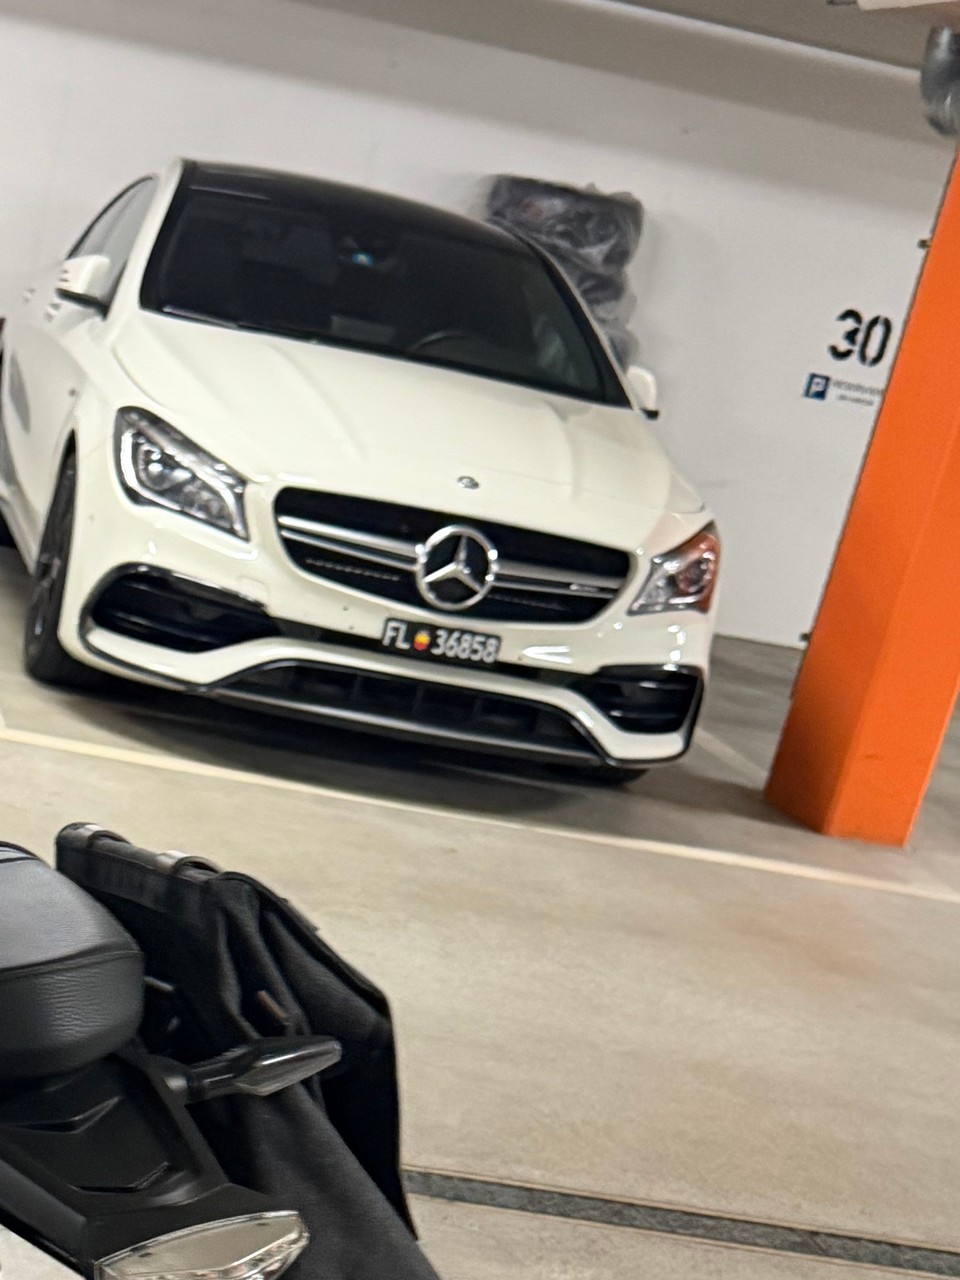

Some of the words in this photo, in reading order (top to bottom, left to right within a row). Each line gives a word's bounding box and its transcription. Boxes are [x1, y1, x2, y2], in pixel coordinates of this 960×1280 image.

[827, 308, 892, 367] 30
[382, 620, 410, 650] FL
[430, 628, 499, 663] 36858
